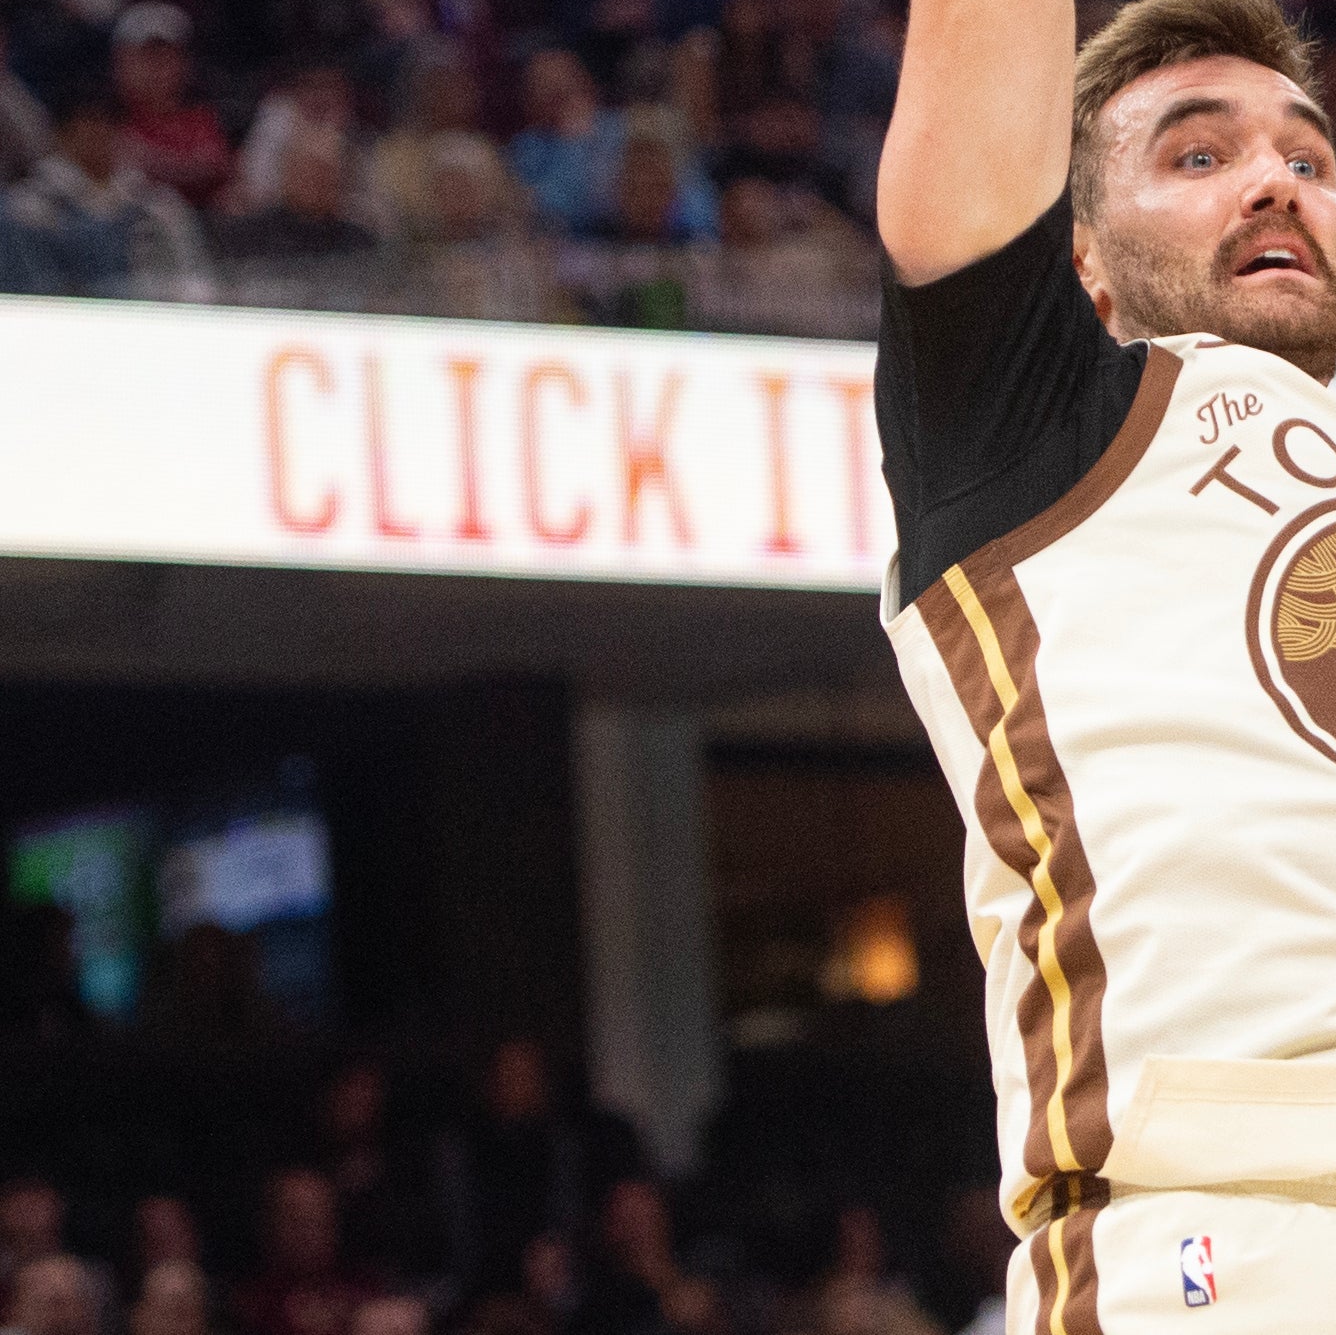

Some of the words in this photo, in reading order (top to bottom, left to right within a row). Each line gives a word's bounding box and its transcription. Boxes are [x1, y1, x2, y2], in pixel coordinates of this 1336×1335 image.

[262, 342, 698, 550] CLICK
[754, 370, 880, 557] IT
[1196, 391, 1264, 446] The
